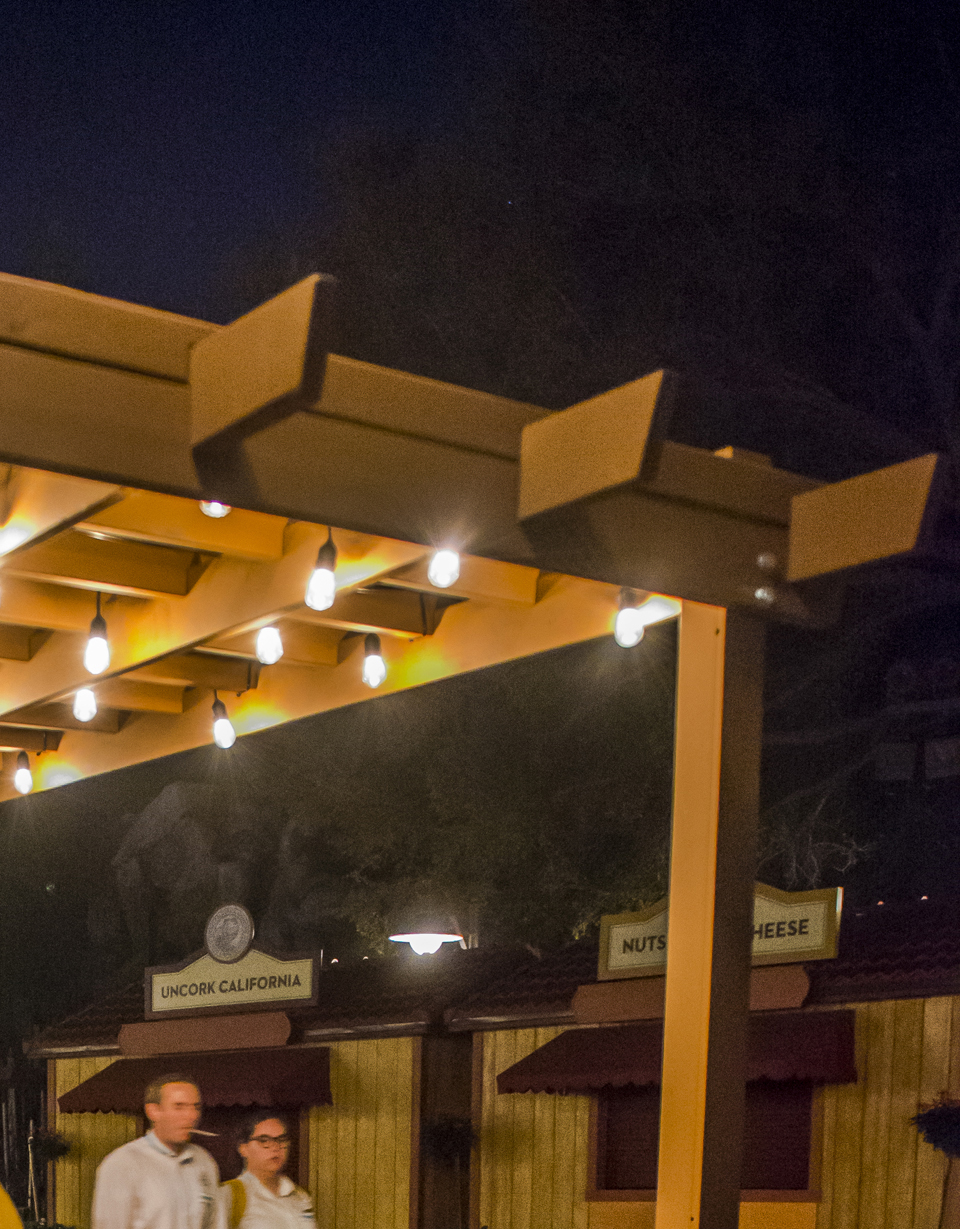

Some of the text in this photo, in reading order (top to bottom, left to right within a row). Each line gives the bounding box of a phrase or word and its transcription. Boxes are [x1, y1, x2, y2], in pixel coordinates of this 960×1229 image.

[622, 919, 810, 954] NUTS HEESE
[161, 974, 302, 999] UNCORK CALIFORNIA
